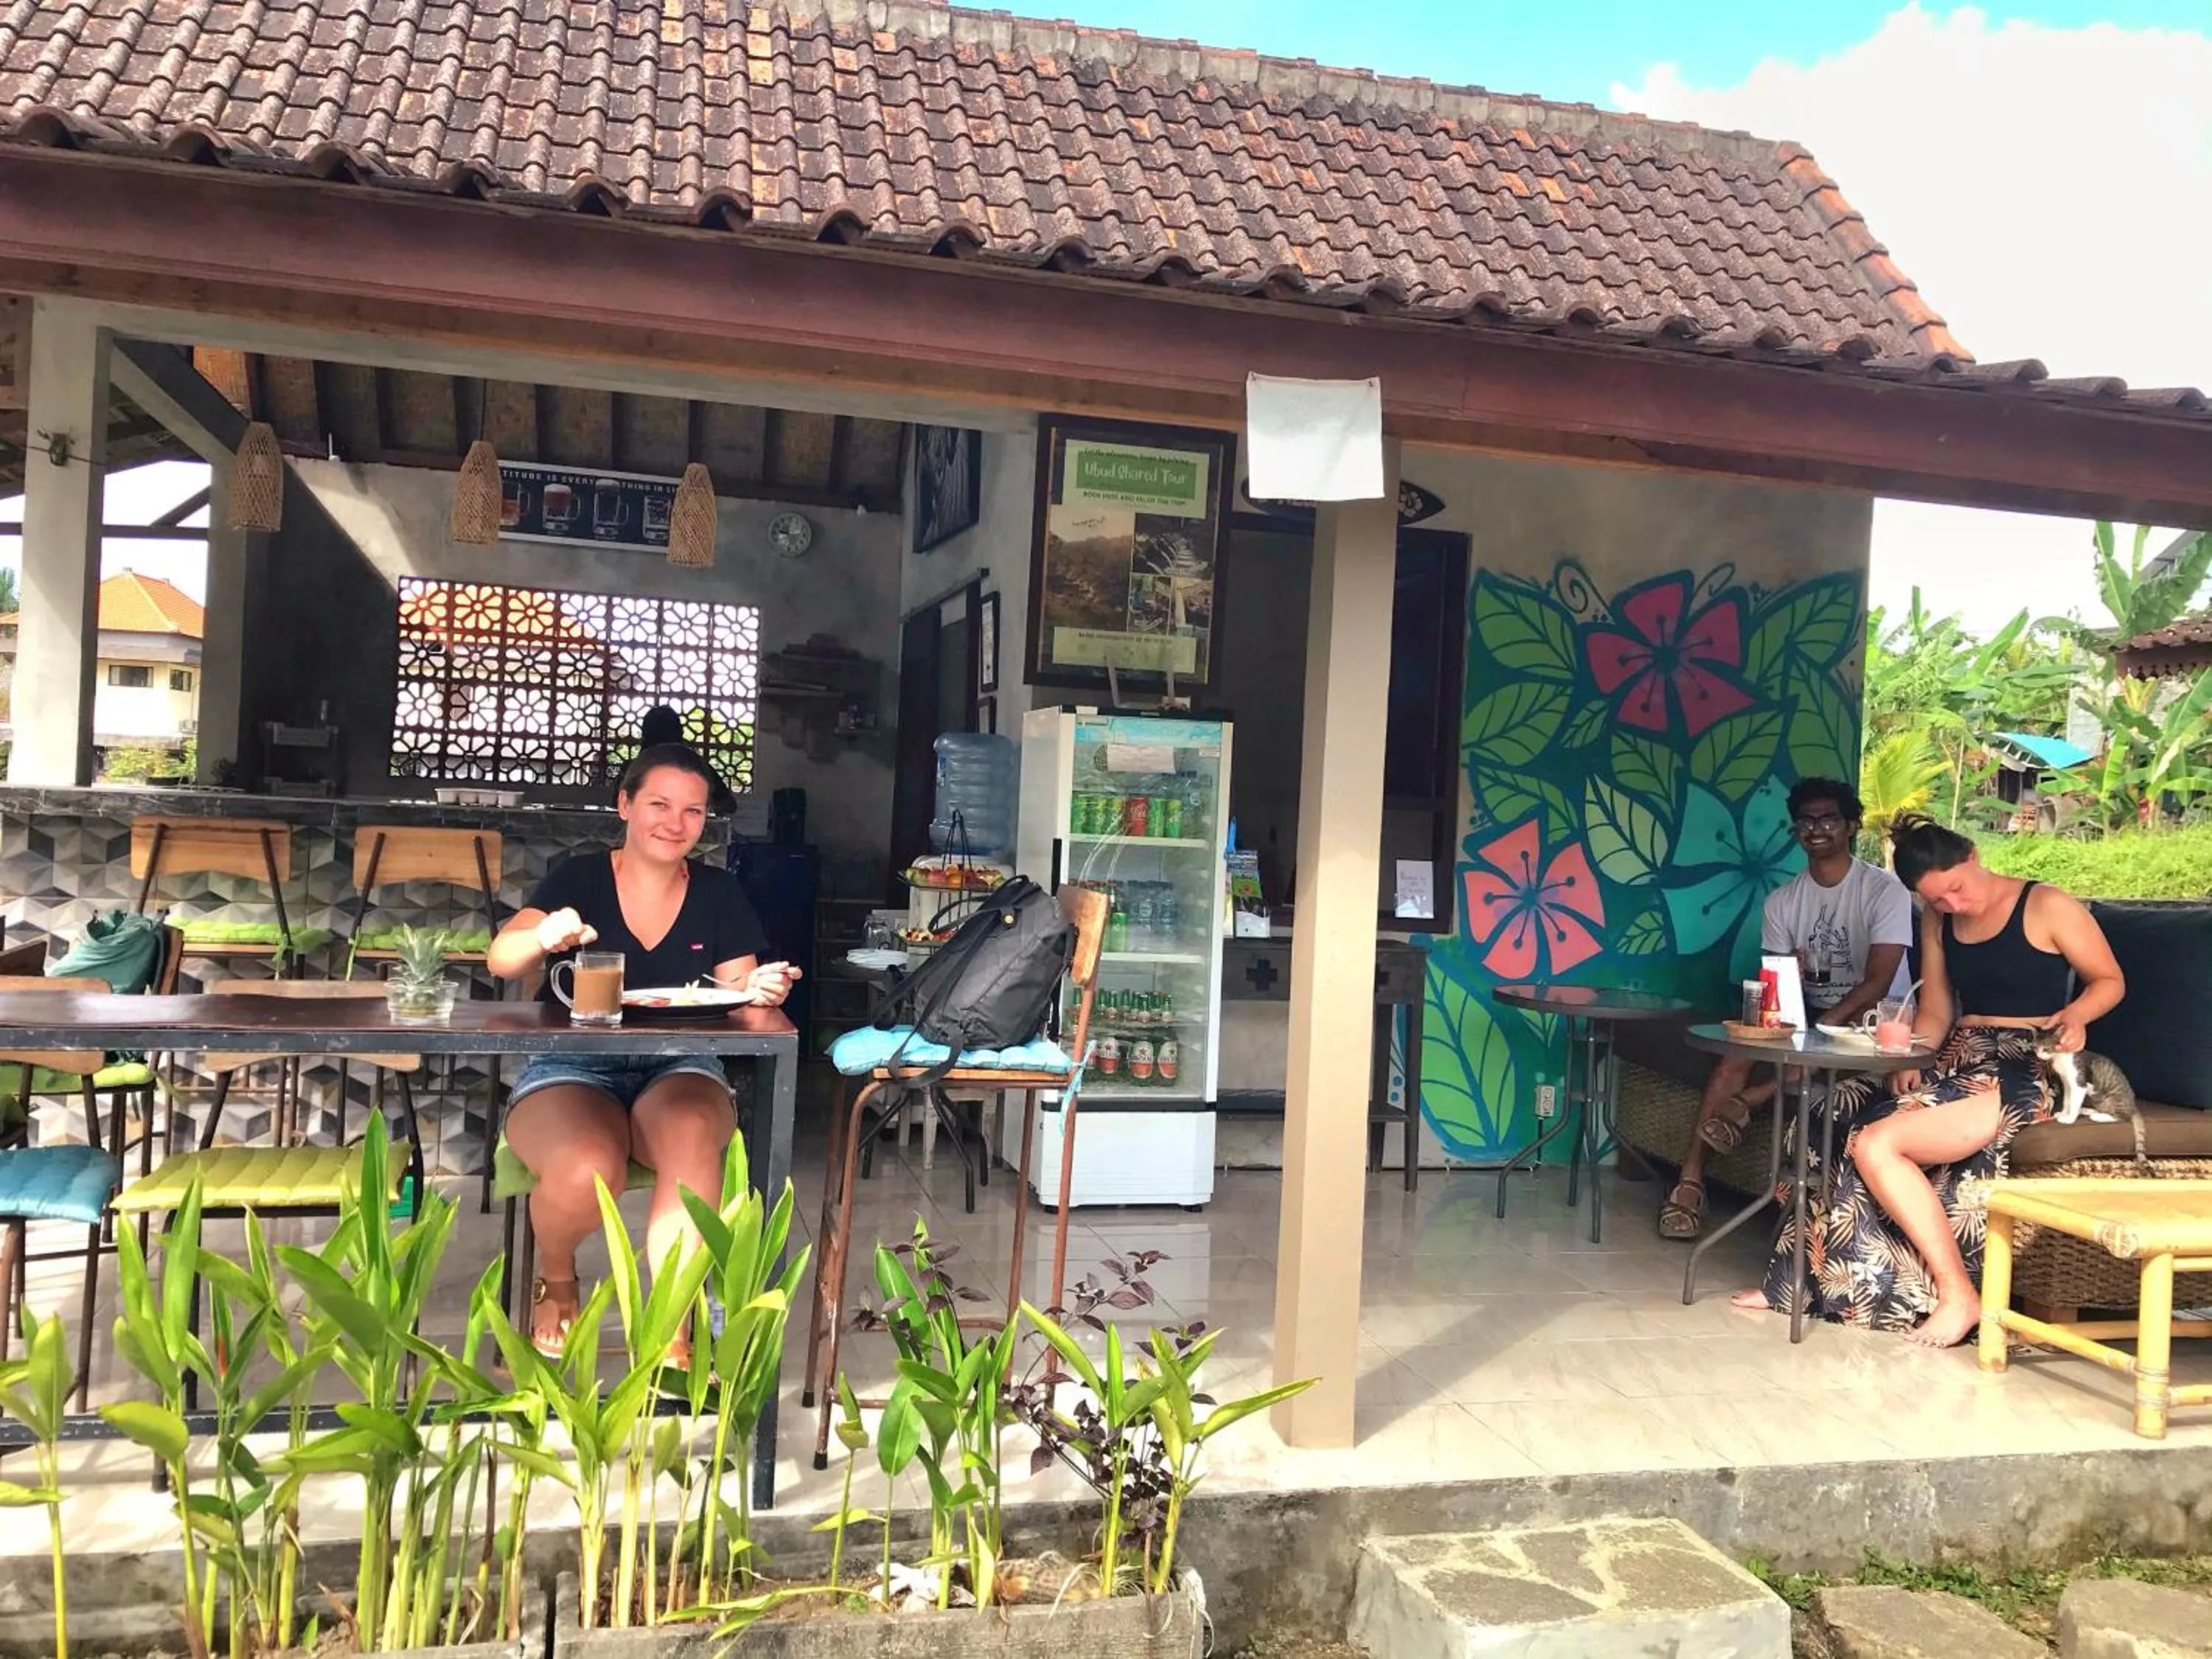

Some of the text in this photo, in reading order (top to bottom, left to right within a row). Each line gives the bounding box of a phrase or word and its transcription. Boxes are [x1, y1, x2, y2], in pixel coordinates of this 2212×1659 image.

[503, 470, 542, 480] TITUDE
[1085, 462, 1186, 484] Ubud Shared Tour
[1120, 495, 1135, 503] AND
